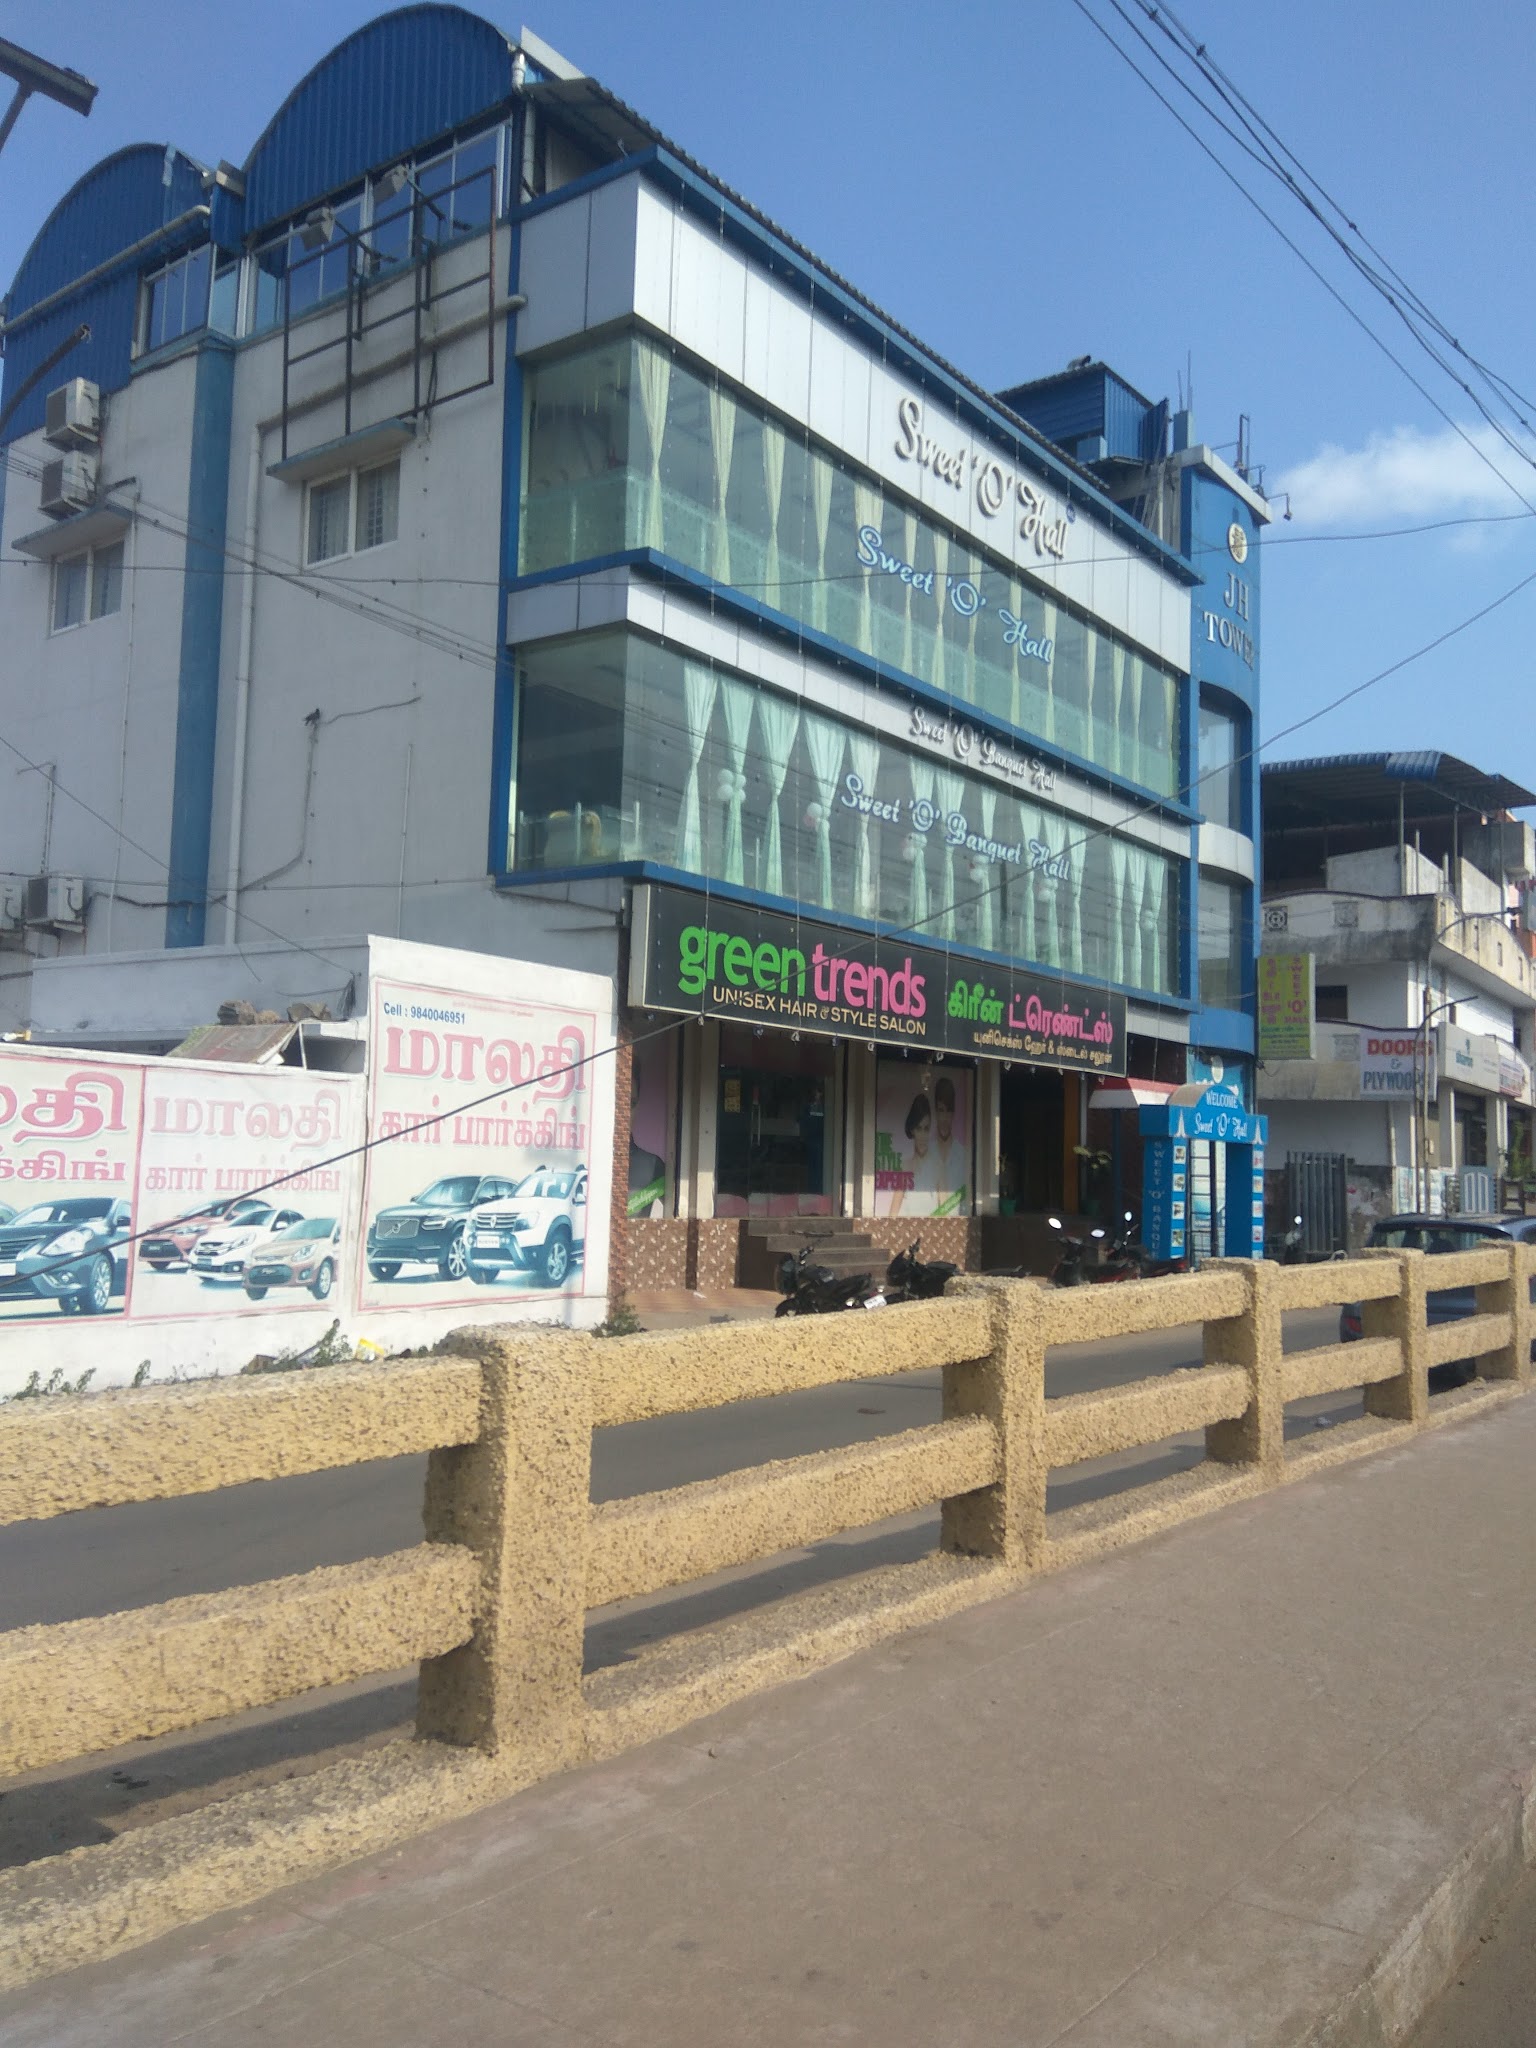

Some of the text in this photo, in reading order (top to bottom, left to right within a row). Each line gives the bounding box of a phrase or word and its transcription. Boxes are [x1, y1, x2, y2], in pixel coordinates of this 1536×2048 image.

[894, 398, 966, 491] Sweet
[1017, 481, 1068, 560] Hall
[857, 525, 934, 595] Sweet
[998, 607, 1055, 663] Hall
[1224, 572, 1249, 622] JH
[910, 706, 948, 744] Sweet
[979, 737, 1029, 780] Banquet
[1030, 759, 1057, 791] Hall
[841, 774, 901, 824] Sweet
[946, 812, 1022, 865] Banquet
[1029, 839, 1072, 882] Hall
[678, 926, 927, 1018] green trends
[384, 1002, 402, 1017] Cell
[410, 1006, 466, 1026] 9840046951
[712, 985, 776, 1011] UNISEX
[780, 998, 817, 1020] HAIR
[831, 1007, 877, 1029] STYLE
[879, 1014, 926, 1036] SALON
[948, 979, 1004, 1025] கிரீன்
[384, 1025, 587, 1104] மாலதி
[1048, 1039, 1055, 1055] &
[149, 1088, 343, 1153] மாலதி
[379, 1094, 586, 1151] கார் பார்க்கிங்
[1194, 1112, 1213, 1134] Sweet
[1232, 1117, 1247, 1140] Hall
[1206, 1091, 1238, 1109] WELCOME
[145, 1152, 210, 1191] கார்
